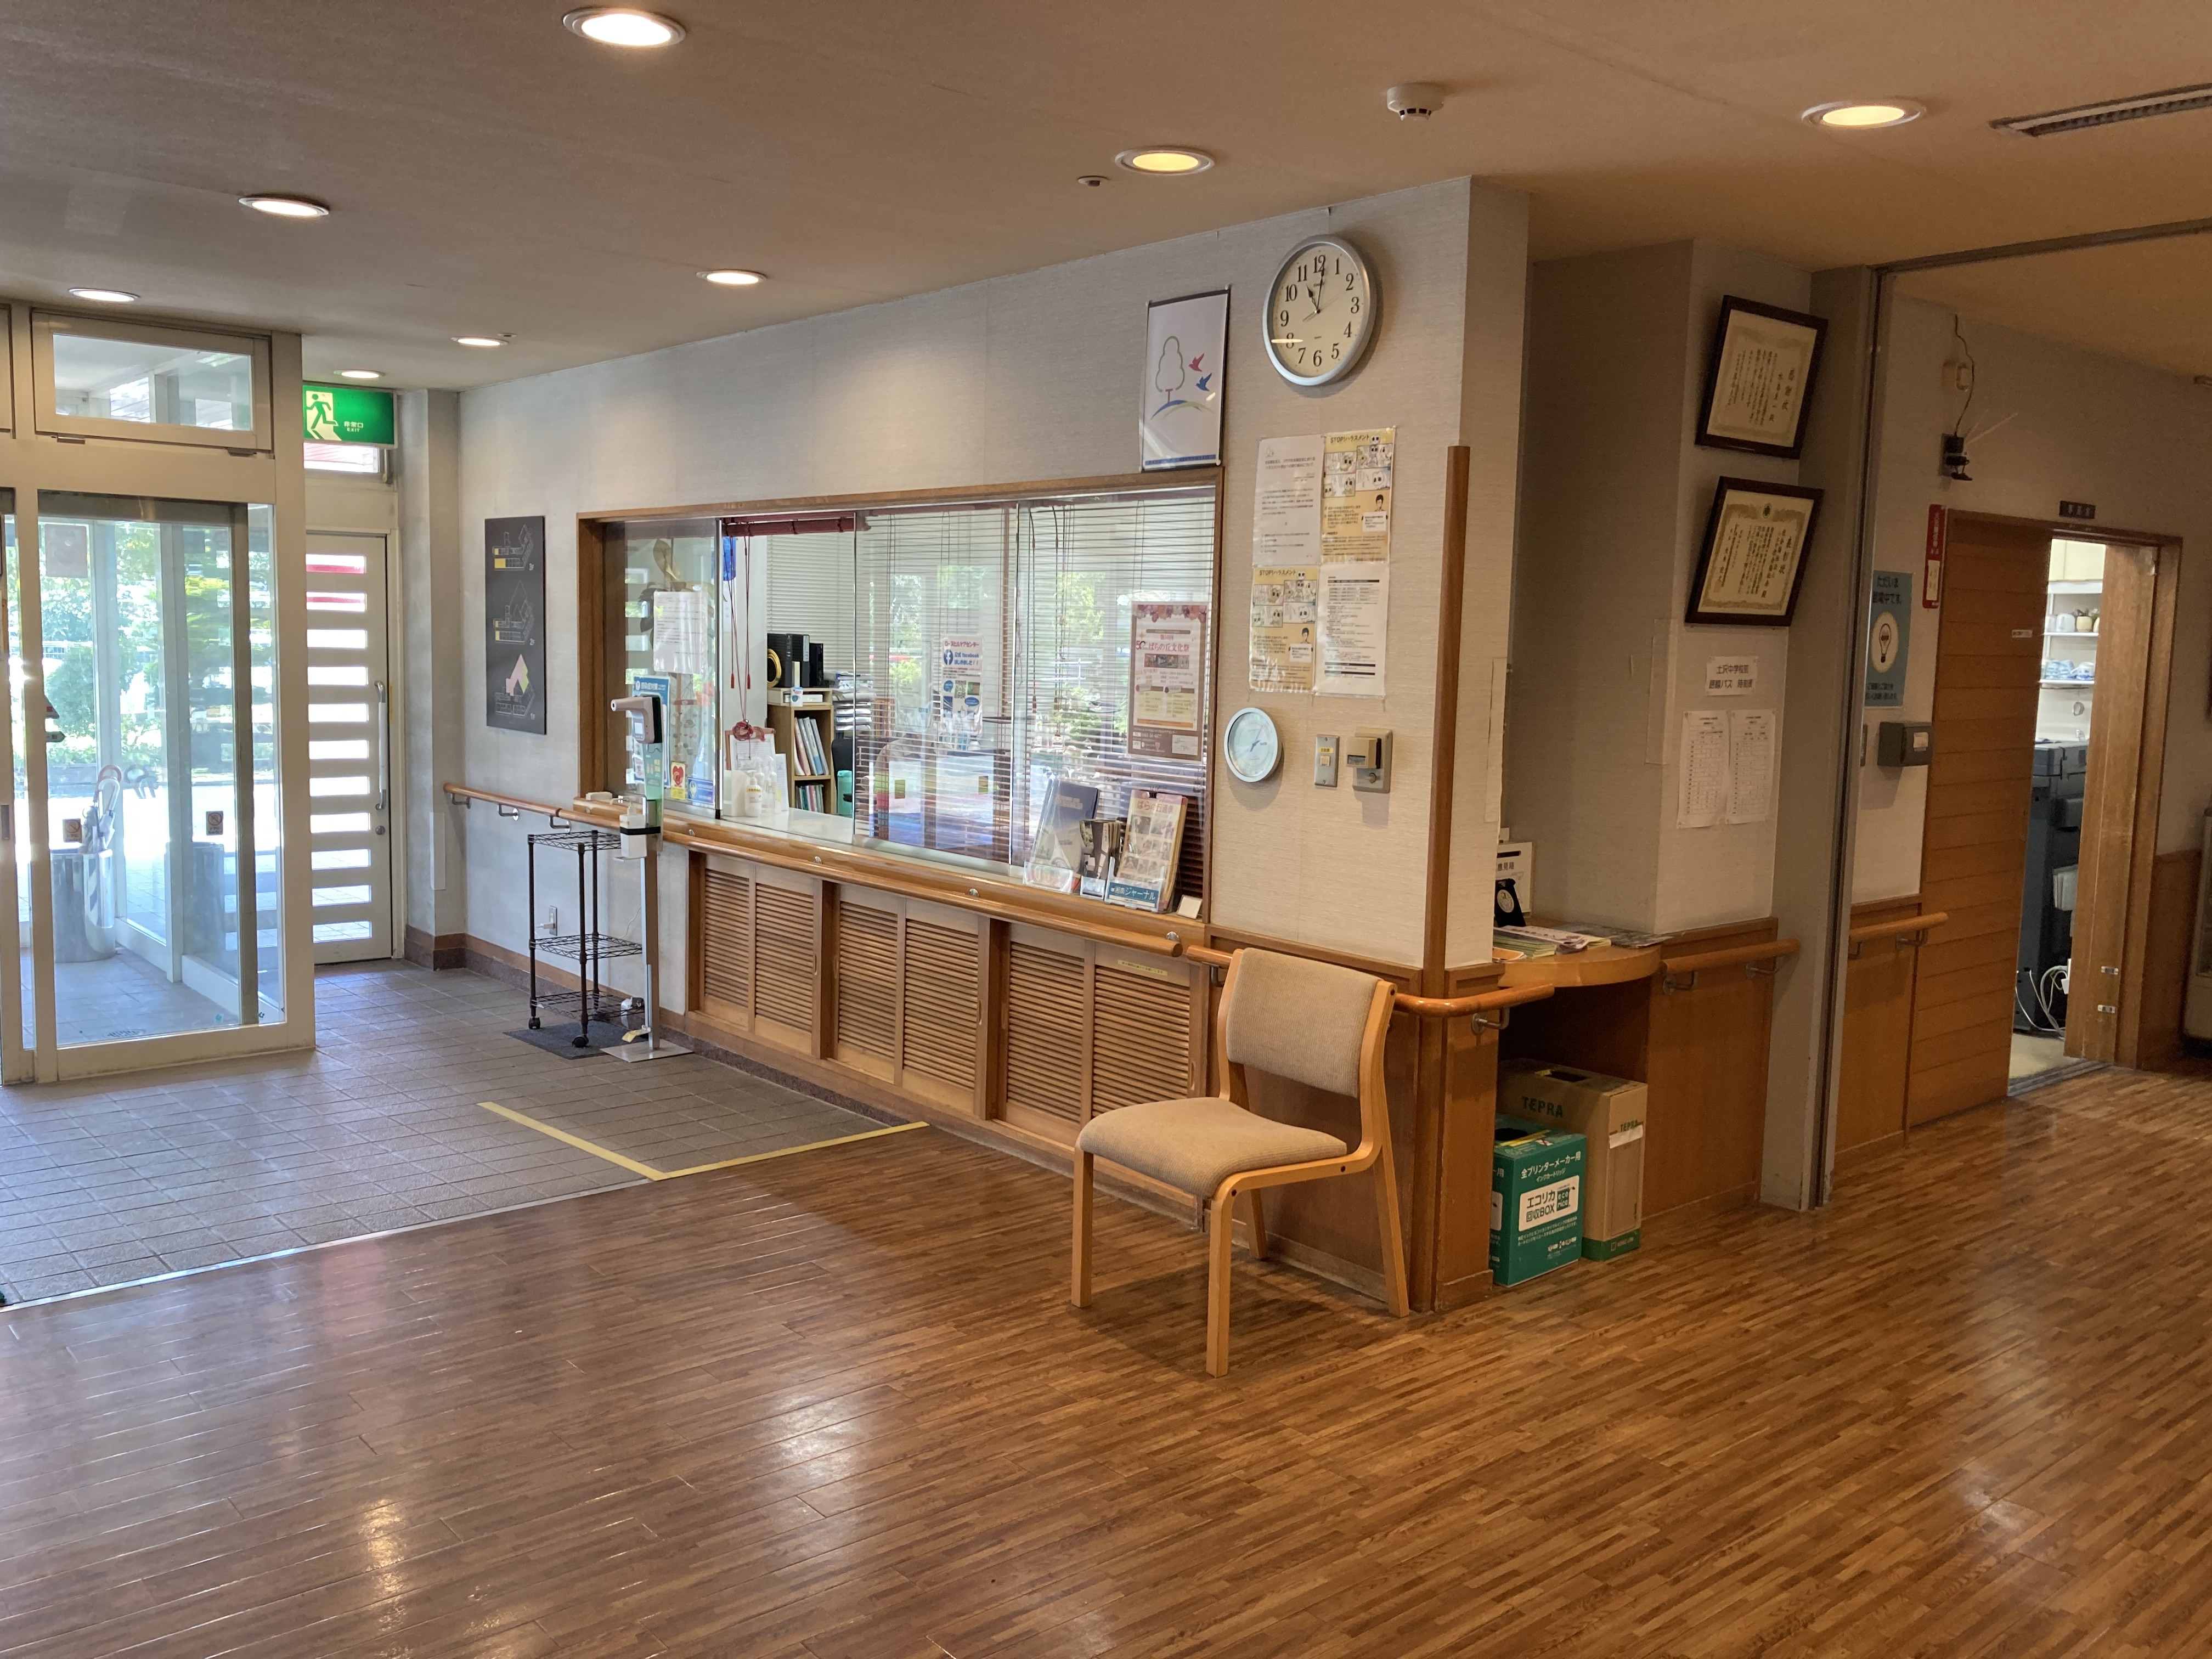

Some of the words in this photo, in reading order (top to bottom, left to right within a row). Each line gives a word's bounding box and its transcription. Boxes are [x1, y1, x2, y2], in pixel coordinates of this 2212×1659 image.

[1297, 264, 1307, 282] 11
[1313, 255, 1326, 274] 12
[1335, 257, 1340, 275] 1
[1345, 273, 1354, 291] 2
[1285, 284, 1297, 302] 10
[1350, 296, 1359, 314] 3
[1280, 310, 1289, 327] 9
[1344, 321, 1352, 337] 4
[1286, 333, 1294, 349] 8
[1297, 347, 1306, 364] 7
[1313, 349, 1322, 367] 6
[1331, 342, 1339, 359] 5
[1877, 575, 1899, 588] ただいま
[1149, 642, 1189, 652] ばらの丘文化祭
[1716, 664, 1749, 674] 土沢中学校前
[1521, 1096, 1564, 1119] TEPRA
[1620, 1119, 1639, 1132] TEPRA
[1520, 1150, 1581, 1179] 全プリンターメーカー用
[1536, 1167, 1566, 1183] インクカートリッジ
[1526, 1189, 1556, 1209] エコリカ
[1558, 1191, 1569, 1199] eco
[1526, 1203, 1555, 1223] 回収BOX
